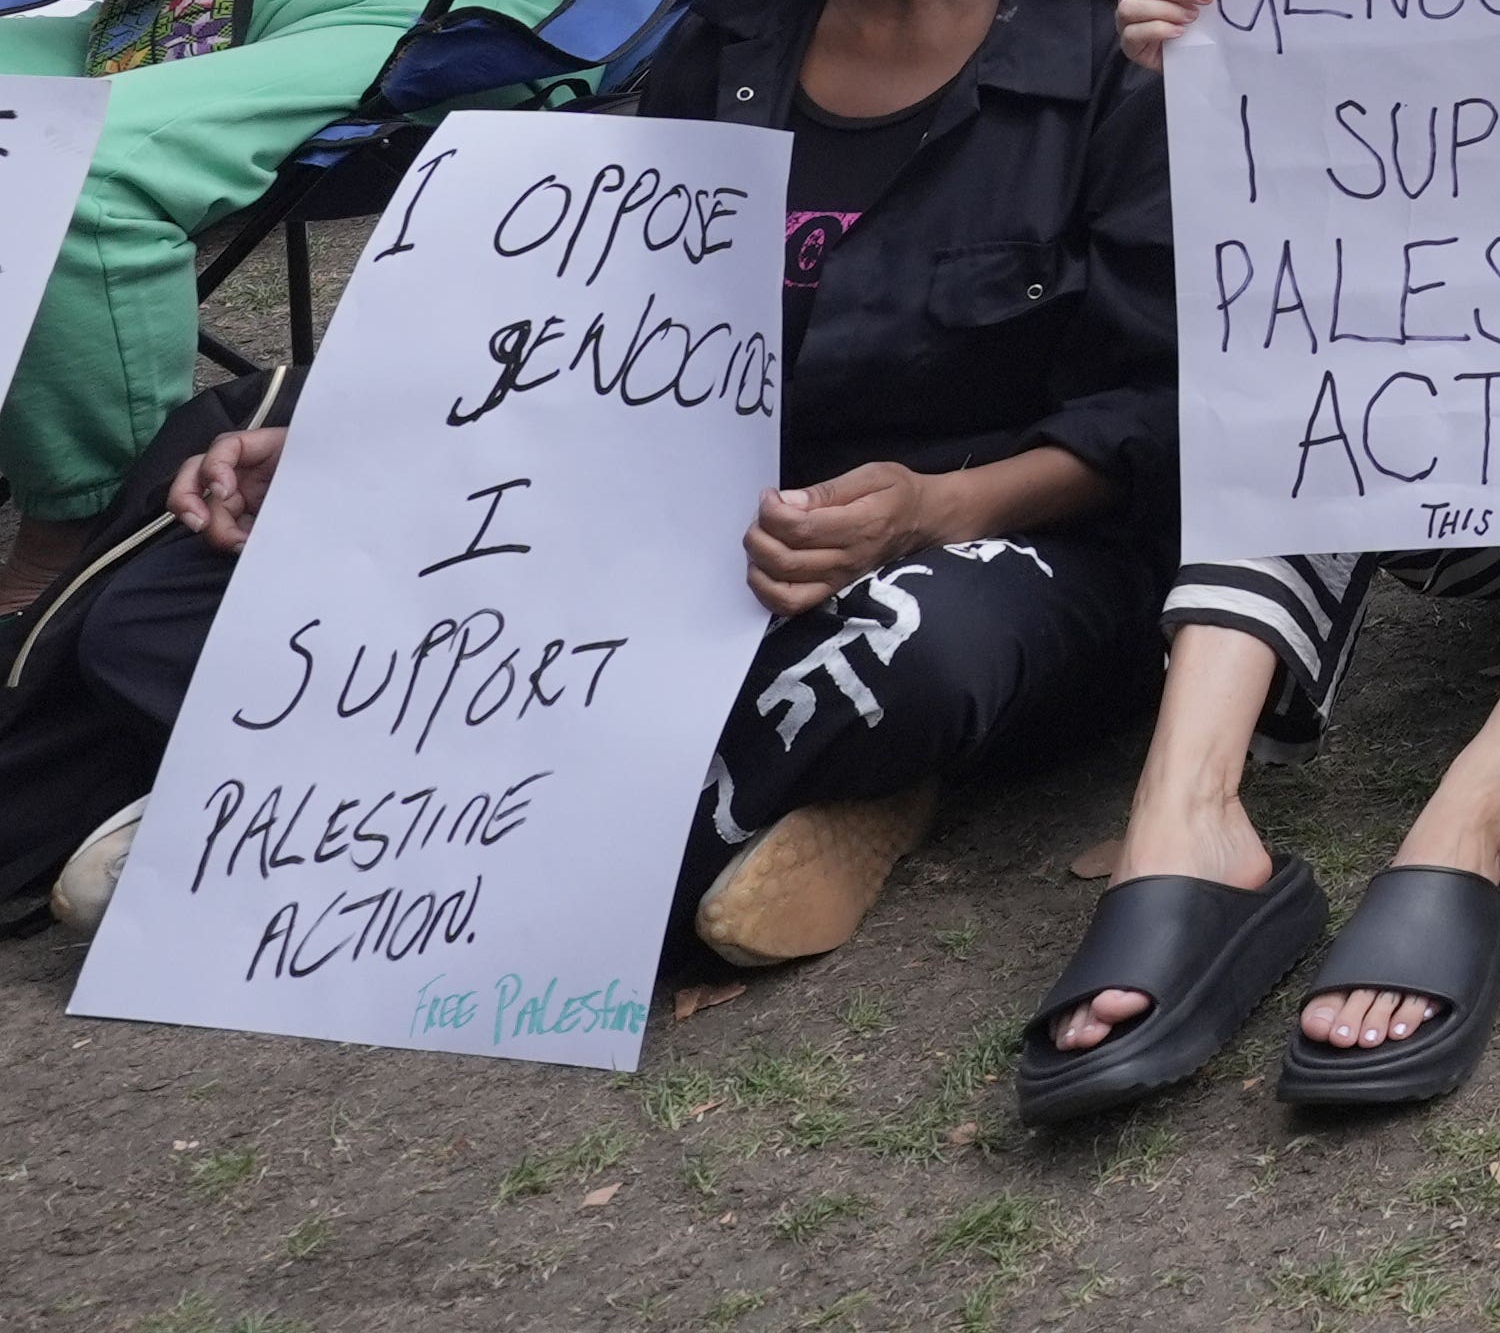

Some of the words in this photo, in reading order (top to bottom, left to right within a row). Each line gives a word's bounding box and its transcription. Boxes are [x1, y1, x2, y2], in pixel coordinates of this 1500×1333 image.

[1239, 93, 1258, 204] I
[373, 149, 454, 263] I
[493, 164, 749, 286] OPPOSE
[418, 477, 531, 578] I
[1421, 501, 1493, 539] THIS
[232, 607, 630, 753] SUPPORT
[246, 873, 477, 983] ACTION.
